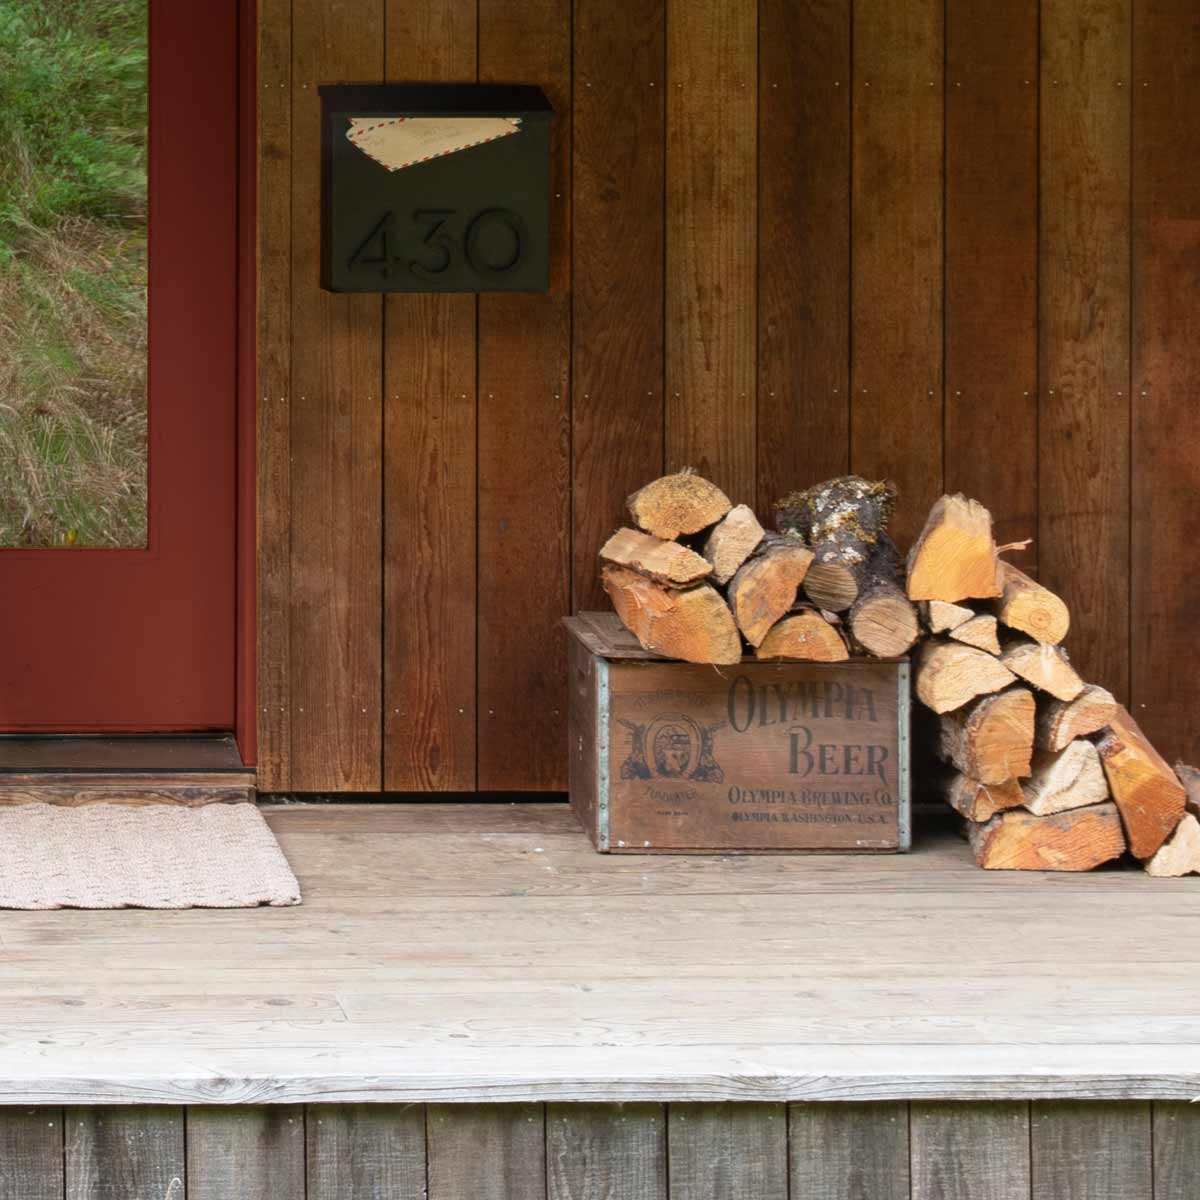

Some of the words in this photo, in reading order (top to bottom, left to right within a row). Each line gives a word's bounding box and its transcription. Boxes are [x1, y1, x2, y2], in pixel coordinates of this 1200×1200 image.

[347, 207, 521, 280] 430
[727, 675, 877, 732] OLYMPIA
[787, 725, 889, 785] BEER
[728, 785, 797, 805] OLYMPIA
[800, 784, 870, 807] BREWING
[731, 812, 778, 824] OLYMPIA
